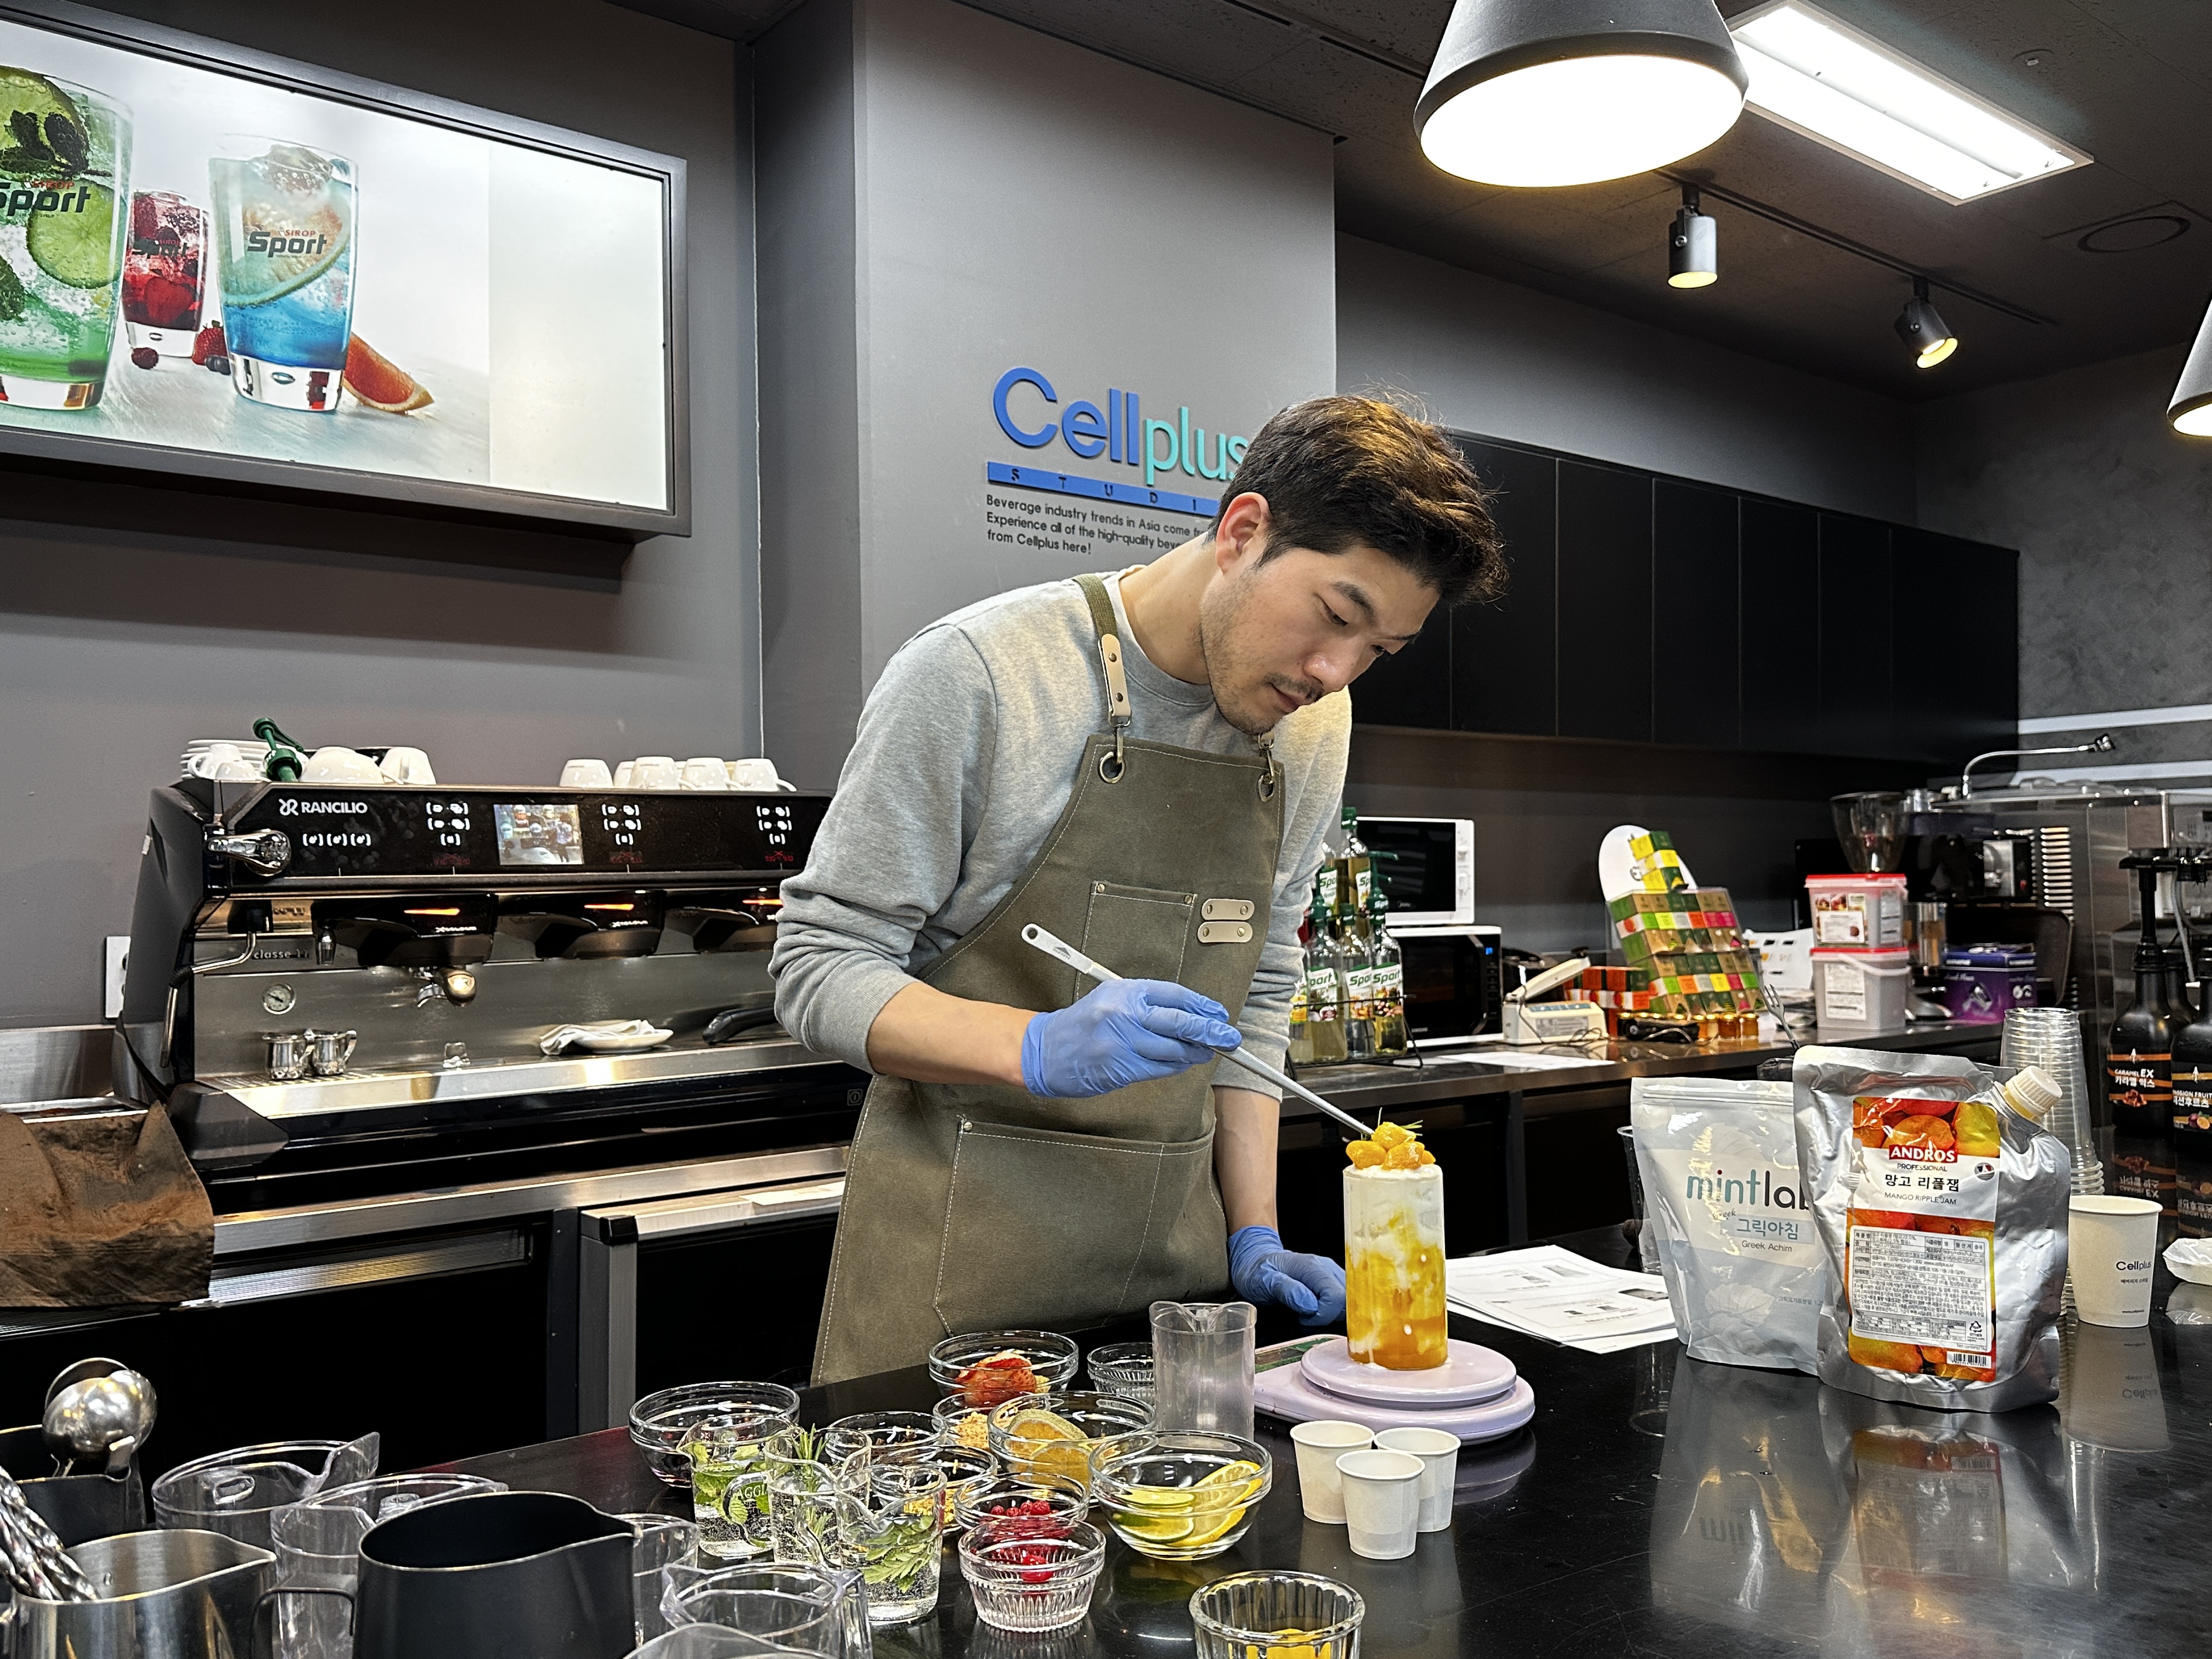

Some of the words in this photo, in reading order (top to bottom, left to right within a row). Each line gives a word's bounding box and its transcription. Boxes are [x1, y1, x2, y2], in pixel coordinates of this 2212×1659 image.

[247, 231, 328, 258] Sport
[1011, 468, 1197, 511] STUDI
[986, 494, 1041, 515] Beverage
[1045, 503, 1087, 523] industry
[1091, 511, 1123, 526] trends
[1126, 516, 1135, 528] in
[1138, 518, 1160, 532] Asia
[1164, 524, 1190, 537] come
[986, 511, 1047, 531] Experience
[1050, 522, 1062, 533] all
[1064, 524, 1076, 535] of
[1079, 525, 1094, 538] the
[1098, 528, 1154, 549] high-quality
[987, 529, 1013, 544] from
[1017, 533, 1059, 550] Cellplus
[1063, 539, 1091, 555] here!
[301, 801, 368, 814] RANCILIO
[253, 950, 291, 959] classe
[1310, 971, 1333, 988] port
[2140, 1068, 2154, 1079] EX
[1891, 1146, 1955, 1162] ANDROS
[1897, 1163, 1948, 1172] PROFESSIONAL
[1885, 1174, 1911, 1187] 망고
[1918, 1177, 1960, 1192] 리플잼
[1884, 1192, 1914, 1200] MANGO
[1736, 1218, 1798, 1240] 그릭아침
[1742, 1240, 1765, 1250] Greek
[1768, 1243, 1792, 1252] Achim
[2116, 1260, 2151, 1271] Cellplus
[737, 1484, 768, 1499] AGGI
